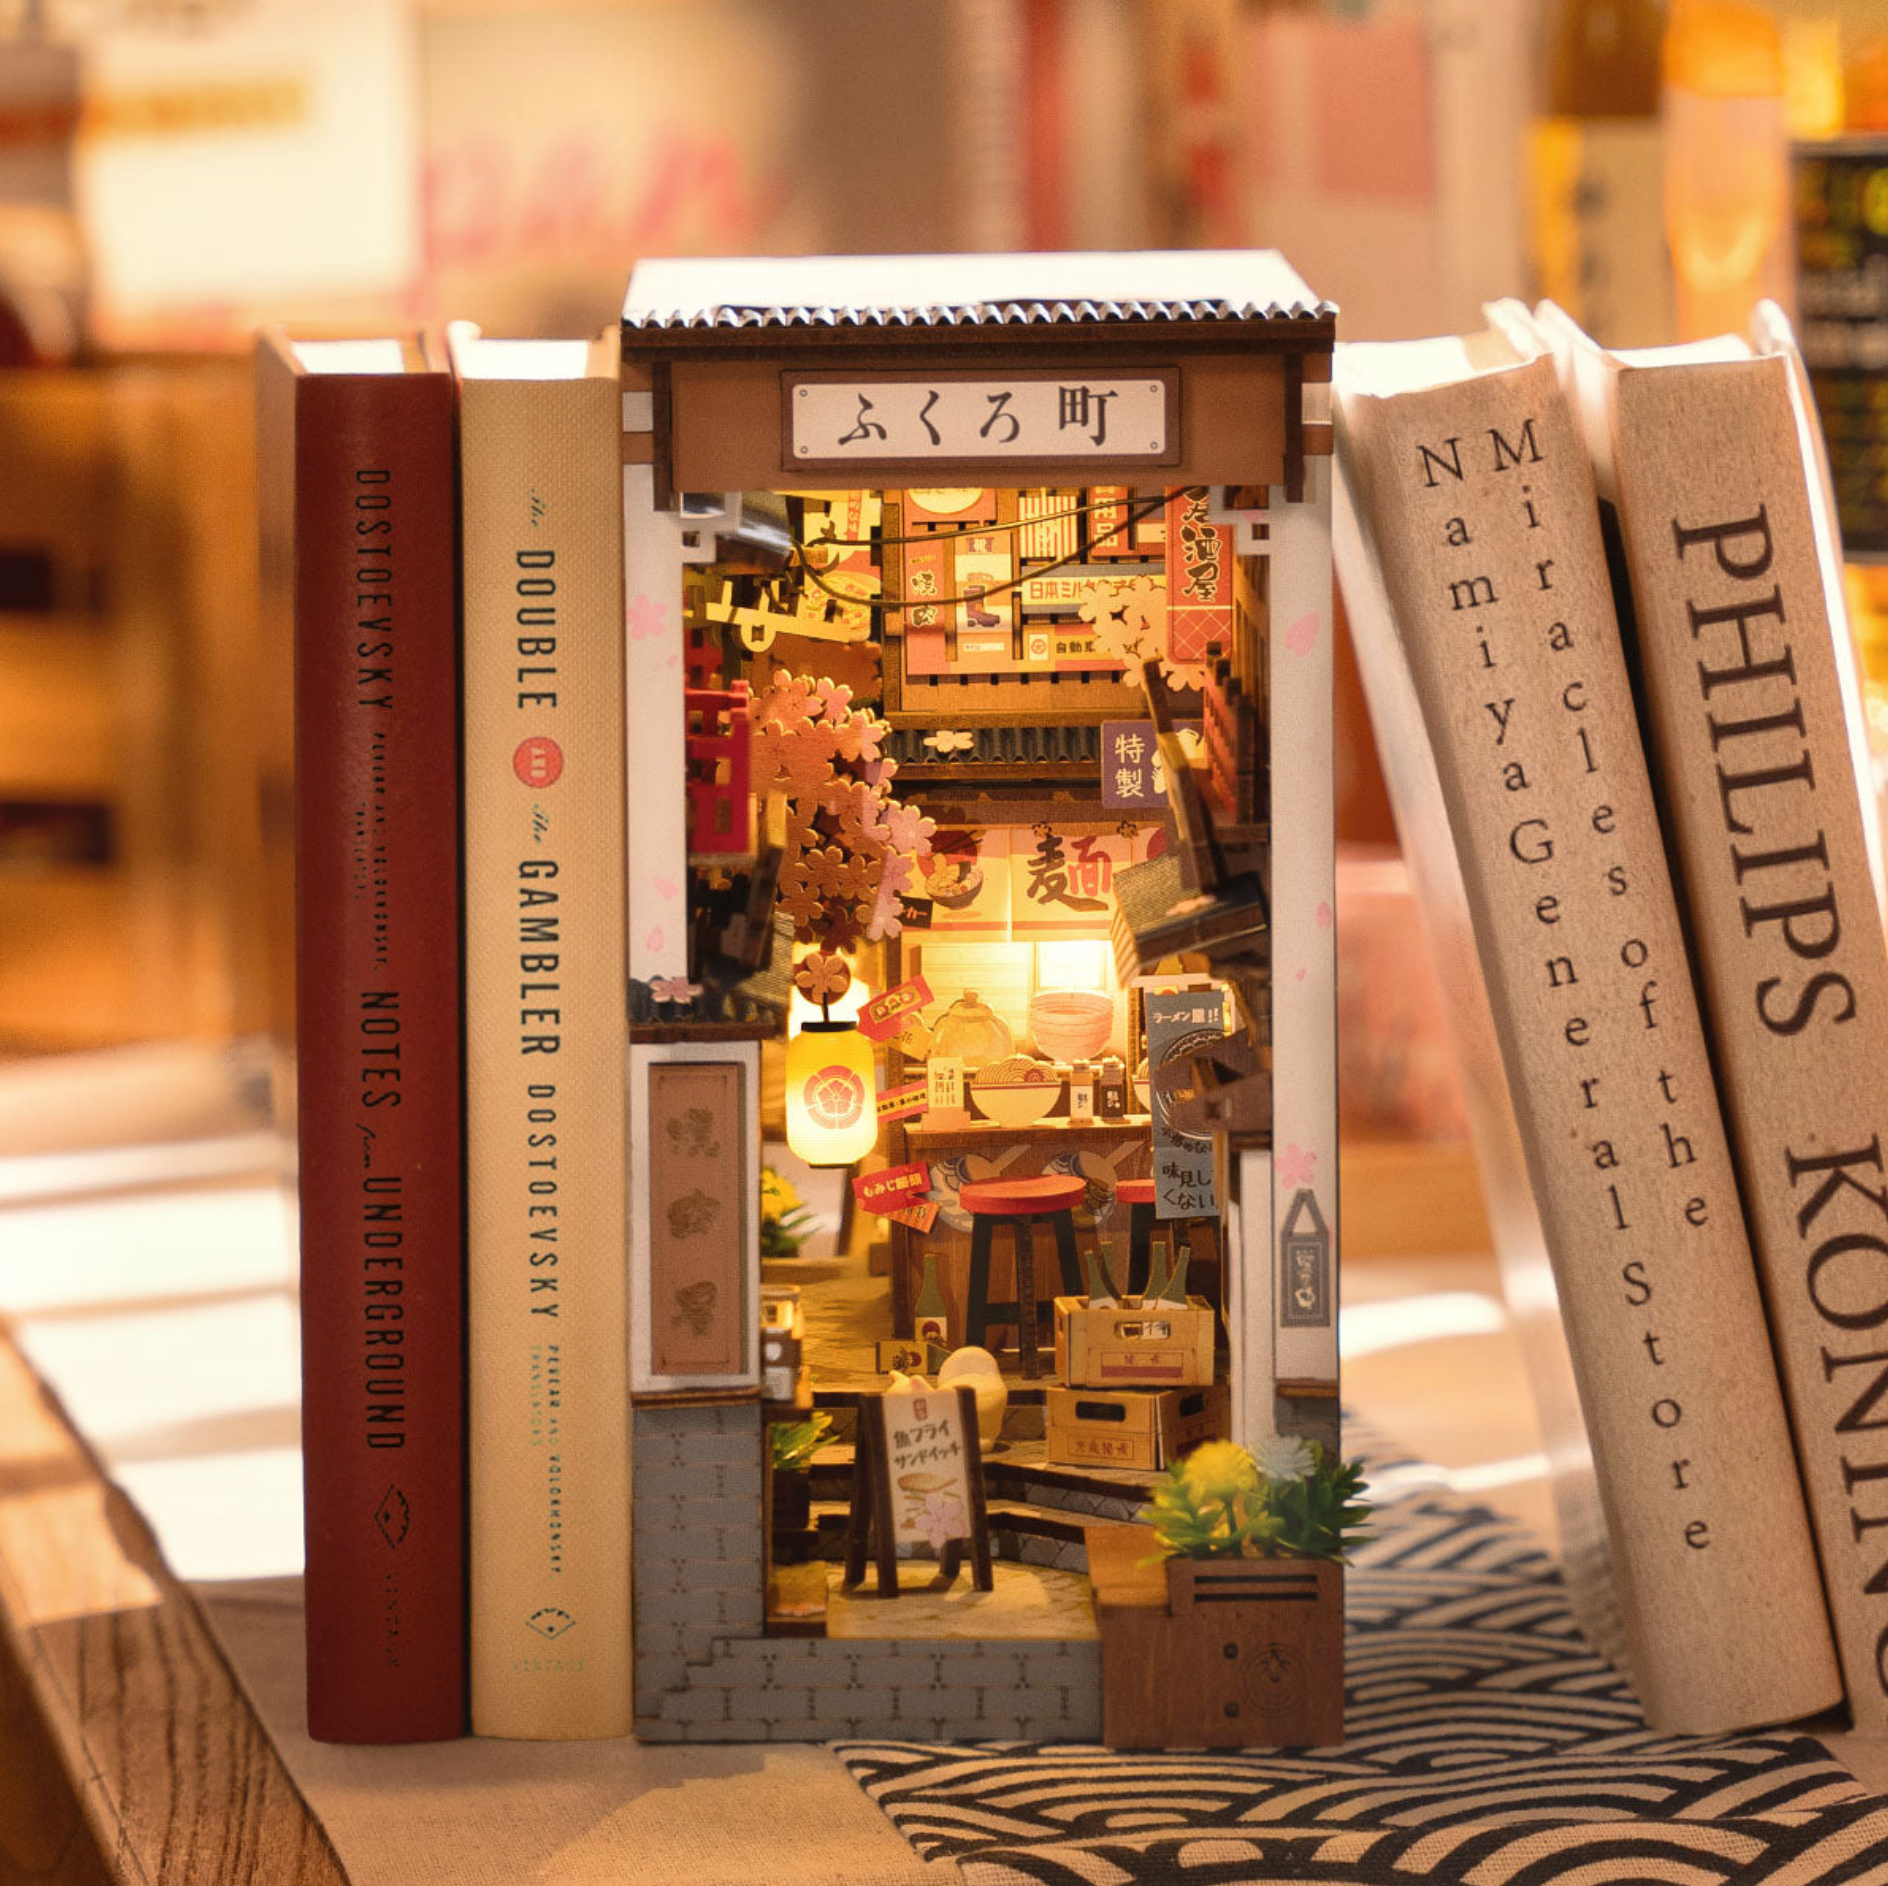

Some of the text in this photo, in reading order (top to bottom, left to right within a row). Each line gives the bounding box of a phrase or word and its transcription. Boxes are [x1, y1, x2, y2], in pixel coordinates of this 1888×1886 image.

[837, 385, 1119, 447] ふくろ町
[355, 469, 394, 710] DOSTOEVSKY
[515, 549, 558, 709] DOUBLE
[1030, 580, 1097, 600] 日本ミル
[1114, 733, 1146, 799] 特製
[1670, 501, 1858, 1038] PHILIPS
[517, 860, 561, 1056] GAMBLER
[360, 991, 402, 1107] NOTES
[526, 1084, 559, 1318] DOSTOEVSKY
[1162, 1162, 1214, 1189] 味見し
[362, 1176, 405, 1449] UNDERGROUND
[547, 1344, 561, 1408] PEVEAR
